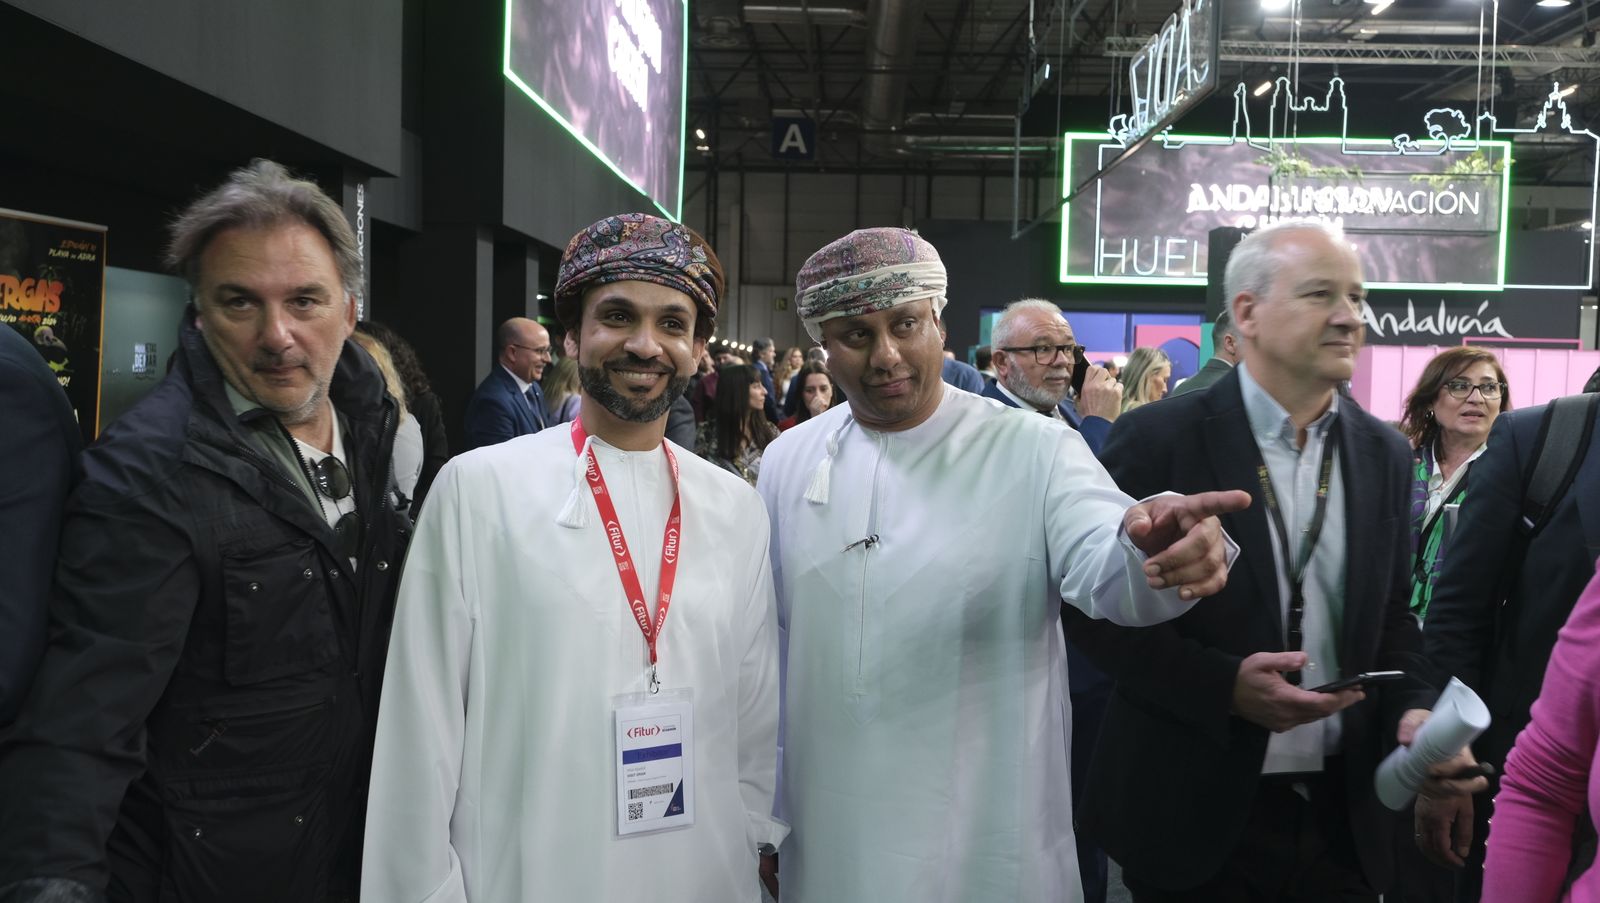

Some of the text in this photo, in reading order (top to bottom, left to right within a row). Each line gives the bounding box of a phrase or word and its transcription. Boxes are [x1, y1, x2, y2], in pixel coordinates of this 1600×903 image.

[778, 123, 808, 154] A
[1360, 299, 1514, 339] Andalucía
[608, 526, 624, 550] Fitur
[664, 534, 678, 557] Fitur
[634, 606, 649, 631] Fitur
[634, 726, 655, 738] Fitur
